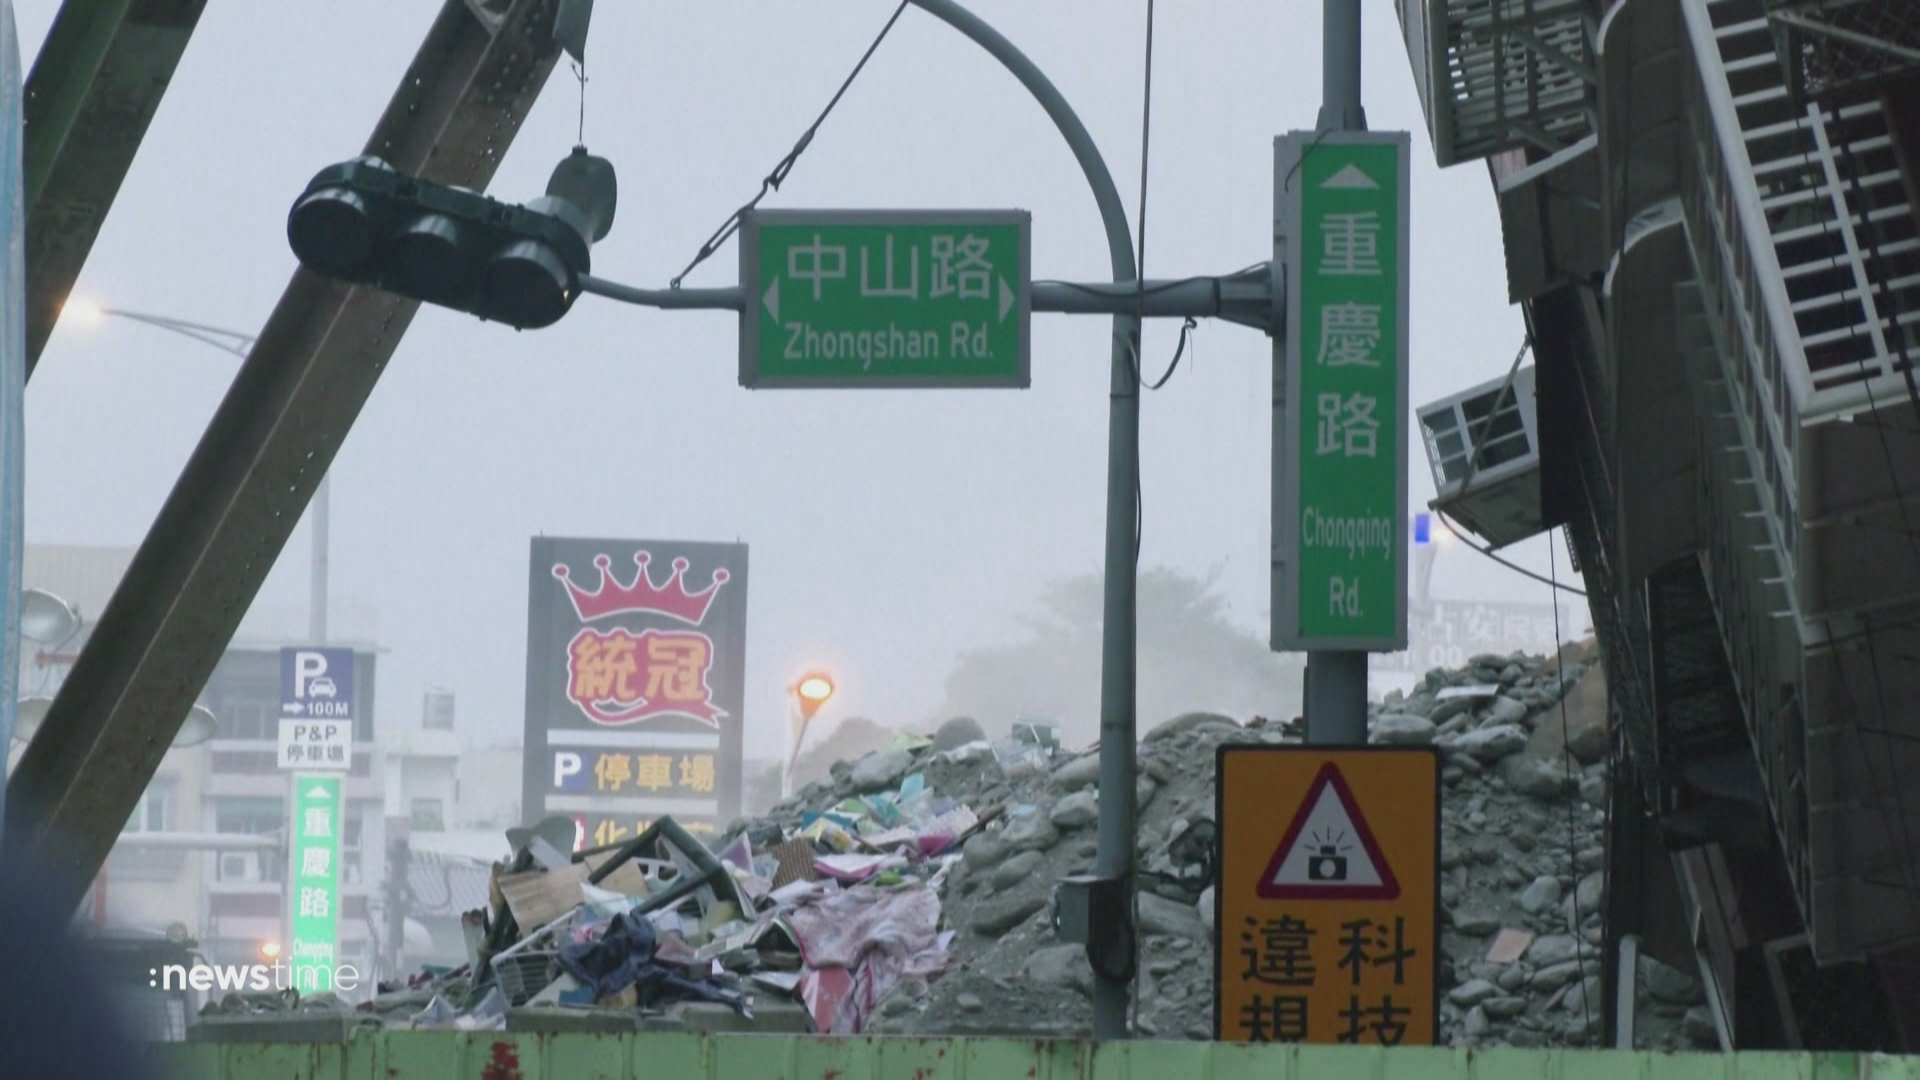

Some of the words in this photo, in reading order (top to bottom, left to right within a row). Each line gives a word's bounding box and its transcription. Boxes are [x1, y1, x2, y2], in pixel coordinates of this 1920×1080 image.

[787, 234, 992, 300] 中山路
[784, 321, 939, 370] Zhongshan
[950, 321, 993, 358] Rd.
[1316, 210, 1382, 458] 重慶路
[1302, 507, 1391, 560] Chongqing
[1329, 575, 1363, 618] Rd.
[295, 651, 327, 698] P
[574, 634, 705, 700] 統冠
[306, 702, 349, 716] 100M
[287, 744, 344, 762] 停車場
[595, 753, 714, 792] 停車場
[301, 806, 332, 917] 重慶路
